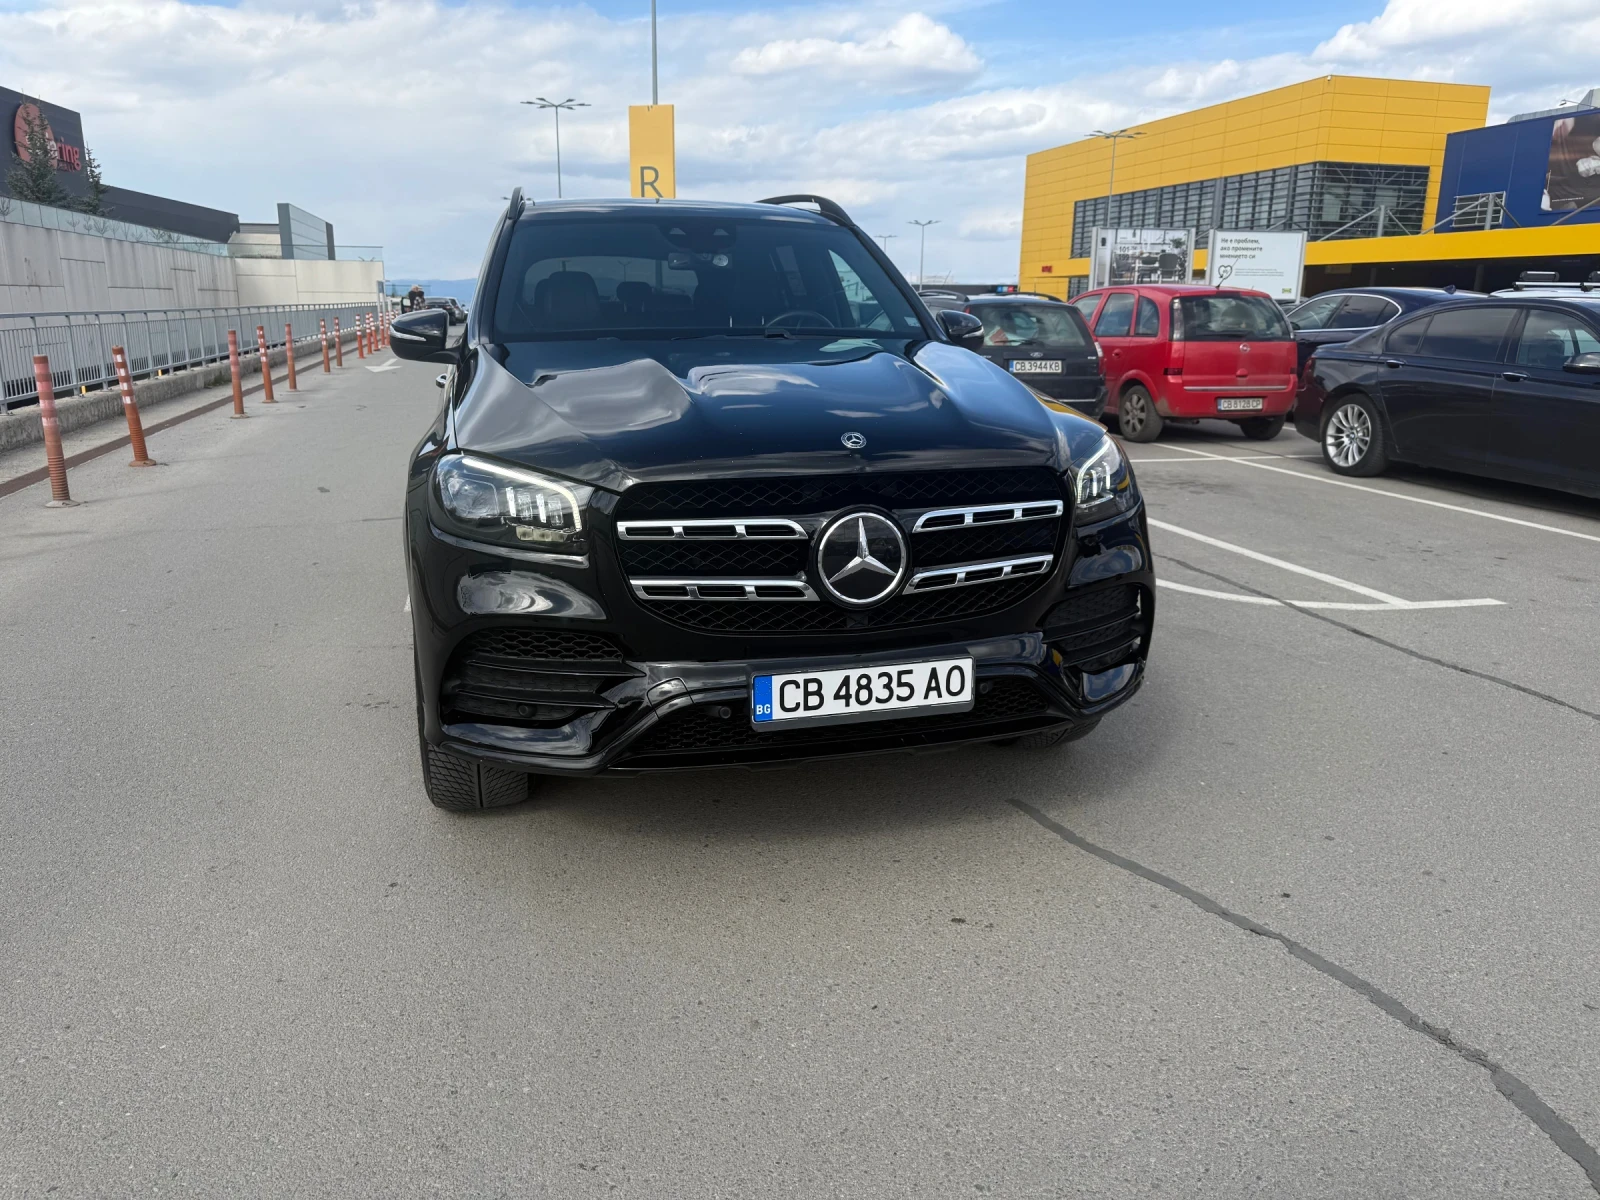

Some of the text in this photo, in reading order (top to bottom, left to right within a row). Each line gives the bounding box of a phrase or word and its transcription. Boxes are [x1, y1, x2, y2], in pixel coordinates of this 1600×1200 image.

[640, 166, 664, 198] R
[1015, 361, 1060, 371] CB 3944 KB
[779, 665, 965, 713] CB 4835 AO
[756, 704, 771, 715] BG
